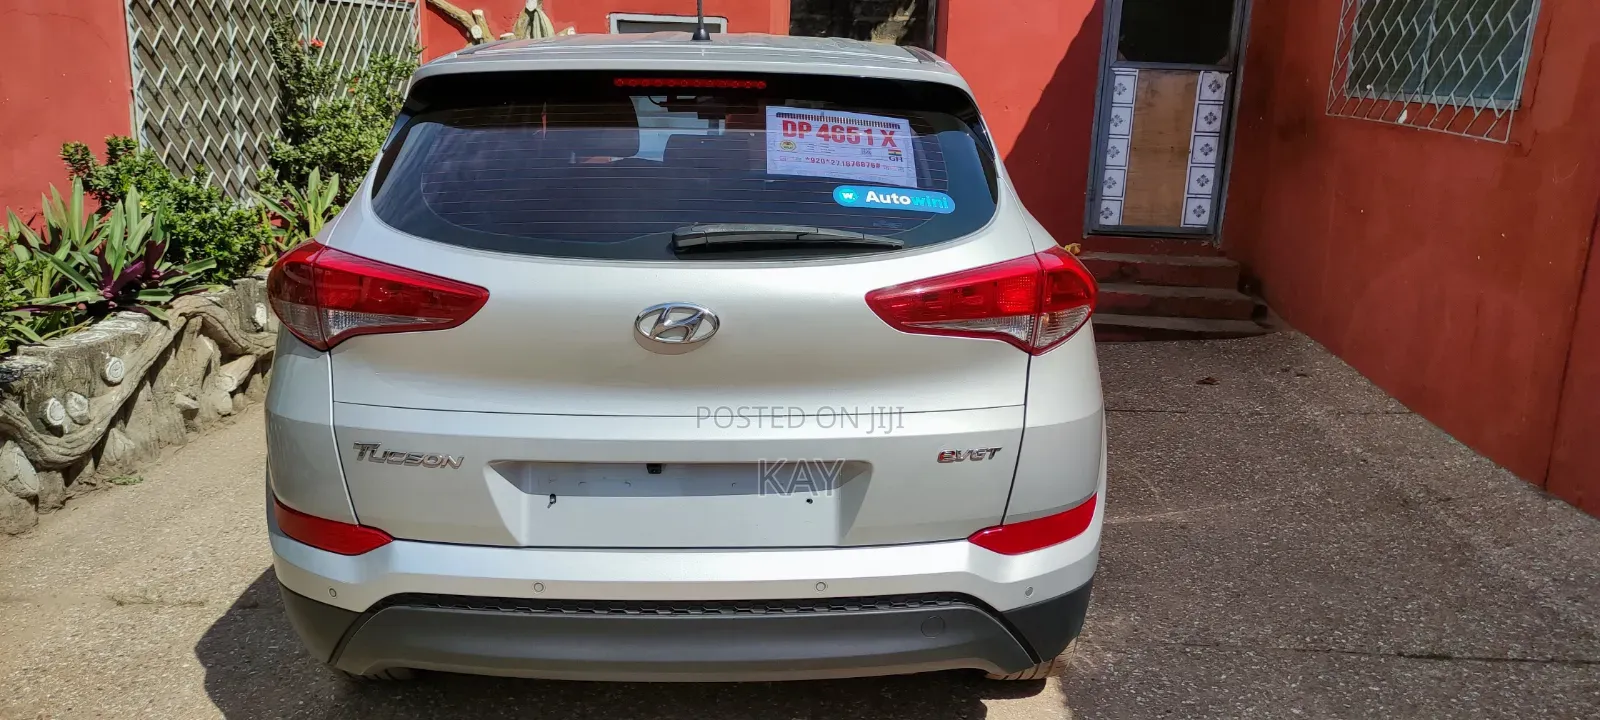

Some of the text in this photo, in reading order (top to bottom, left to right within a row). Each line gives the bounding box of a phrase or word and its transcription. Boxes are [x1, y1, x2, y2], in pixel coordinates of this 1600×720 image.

[782, 120, 898, 148] DP 4651 X
[865, 190, 949, 209] Autowini
